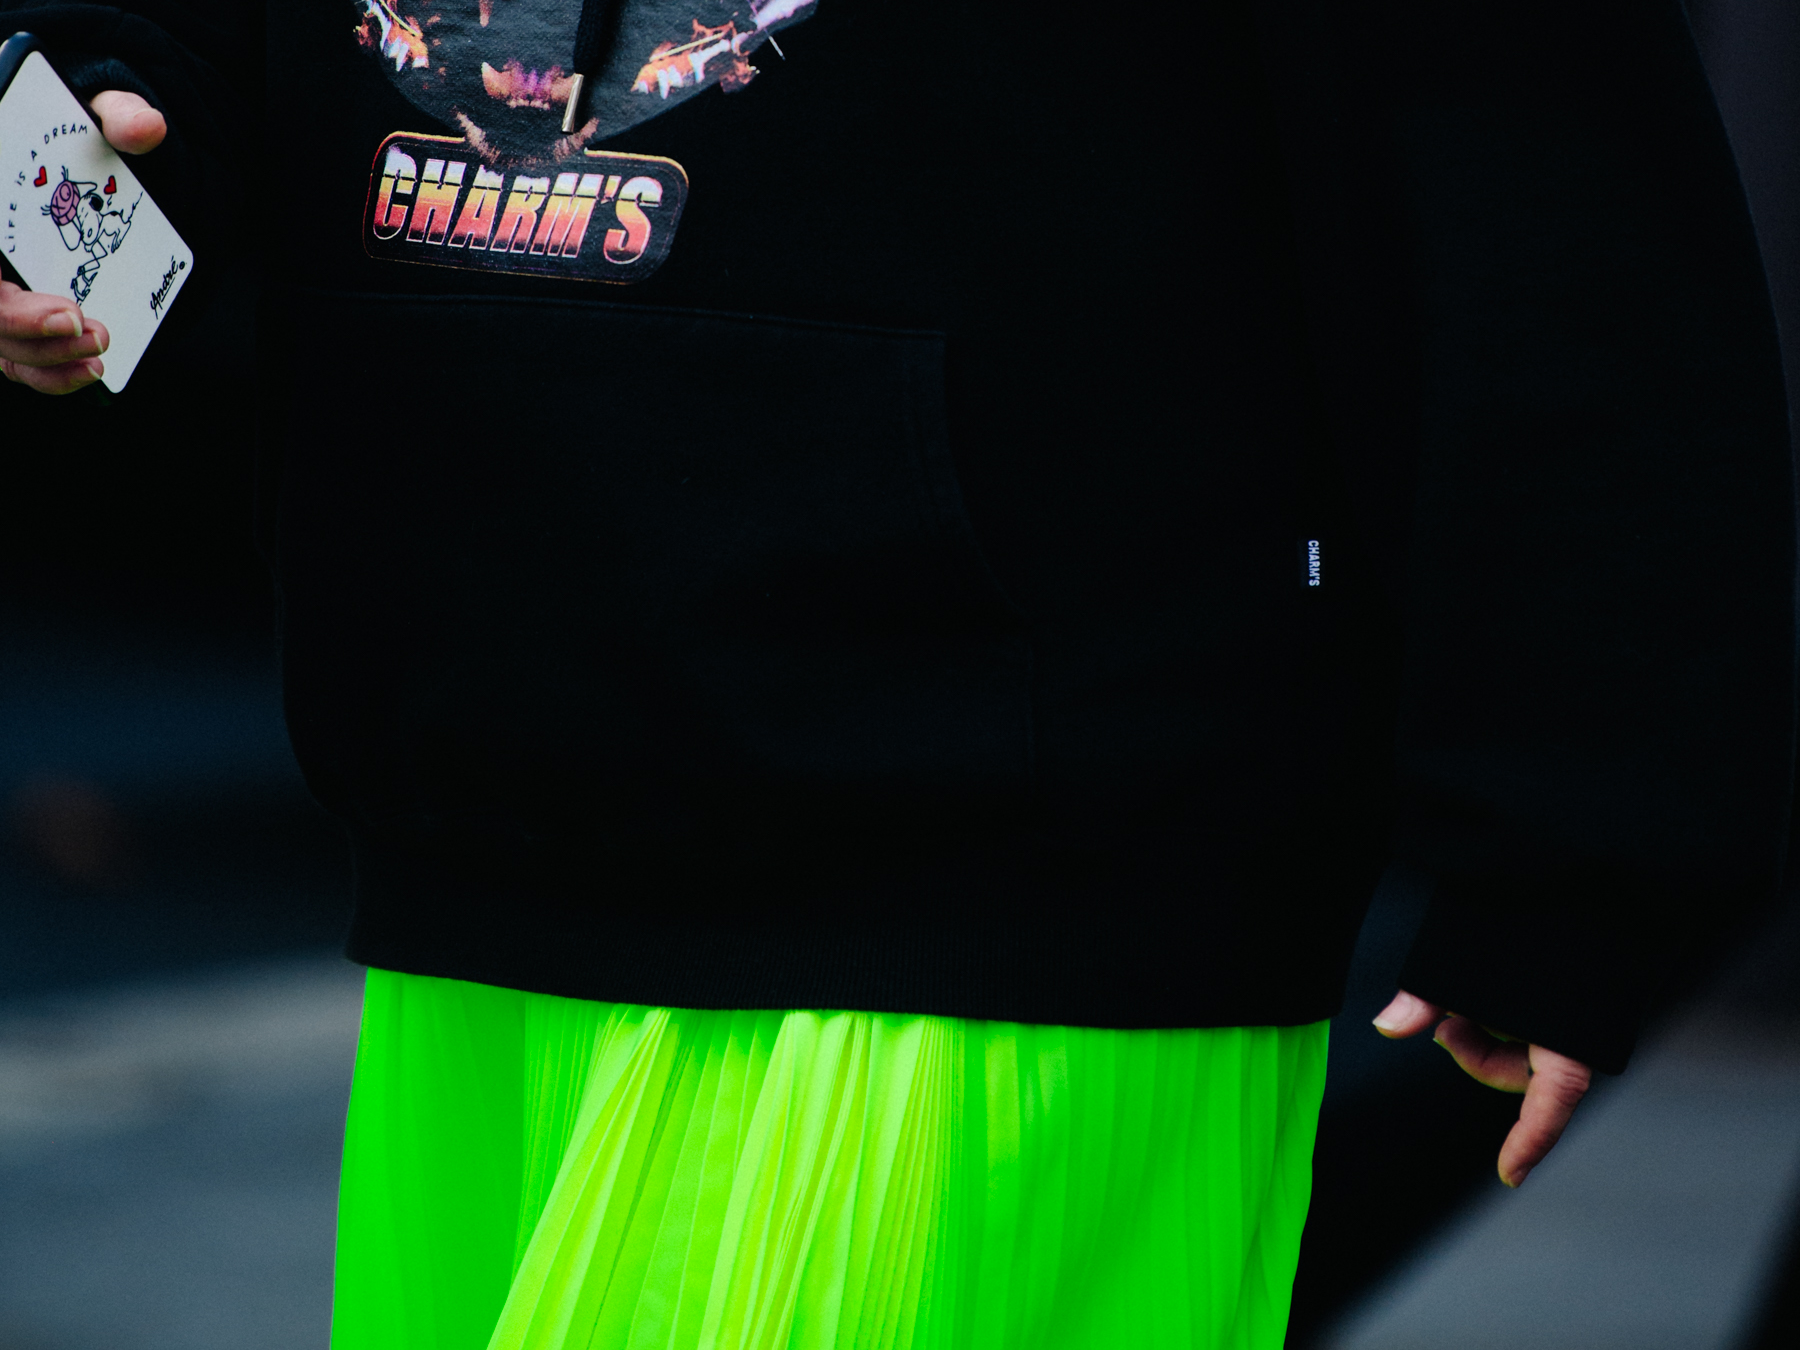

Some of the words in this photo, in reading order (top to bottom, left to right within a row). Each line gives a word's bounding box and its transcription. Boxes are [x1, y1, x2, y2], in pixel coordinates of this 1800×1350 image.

[30, 149, 38, 162] A
[43, 123, 88, 145] DREAM
[373, 144, 663, 266] CHARM'S
[1308, 540, 1321, 586] CHARM'S
